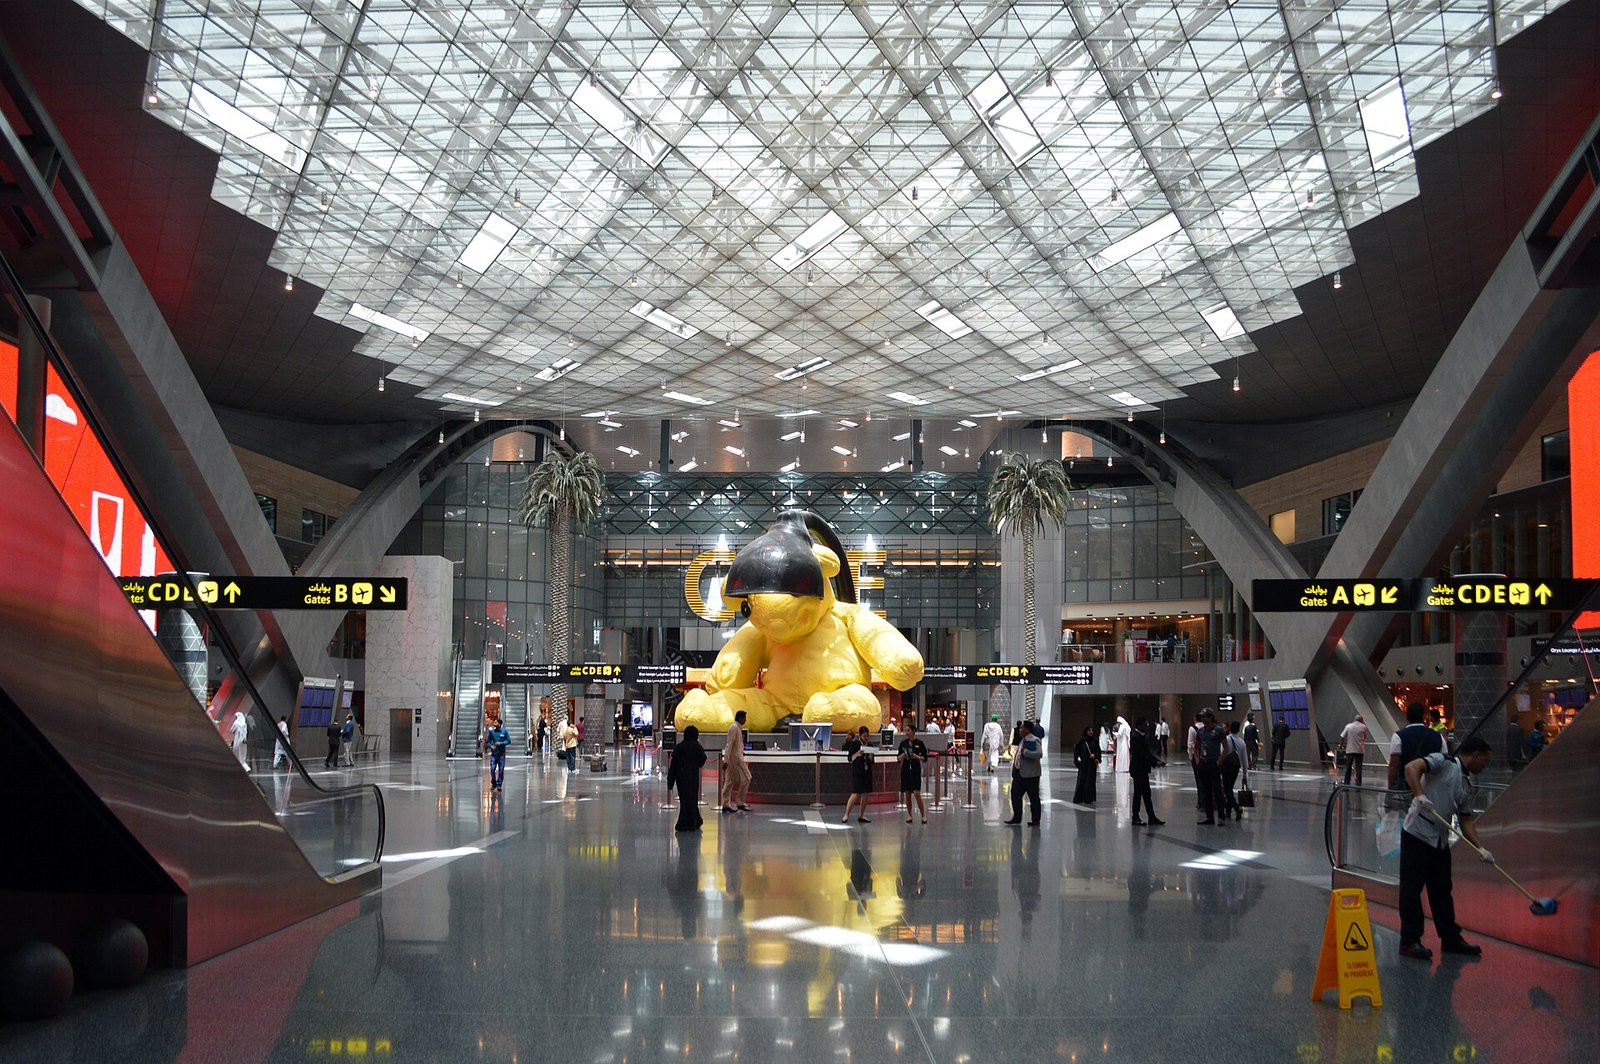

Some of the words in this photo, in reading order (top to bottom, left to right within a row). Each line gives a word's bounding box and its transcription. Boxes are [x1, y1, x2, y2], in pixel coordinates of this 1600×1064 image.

[308, 583, 331, 594] بوابات
[335, 584, 348, 603] B
[1304, 585, 1328, 596] بوابات
[1431, 584, 1454, 595] بوابات
[130, 594, 145, 604] tes
[304, 594, 331, 605] Gates
[1332, 585, 1350, 605] A
[1427, 595, 1454, 606] Gates
[1300, 596, 1328, 607] Gates
